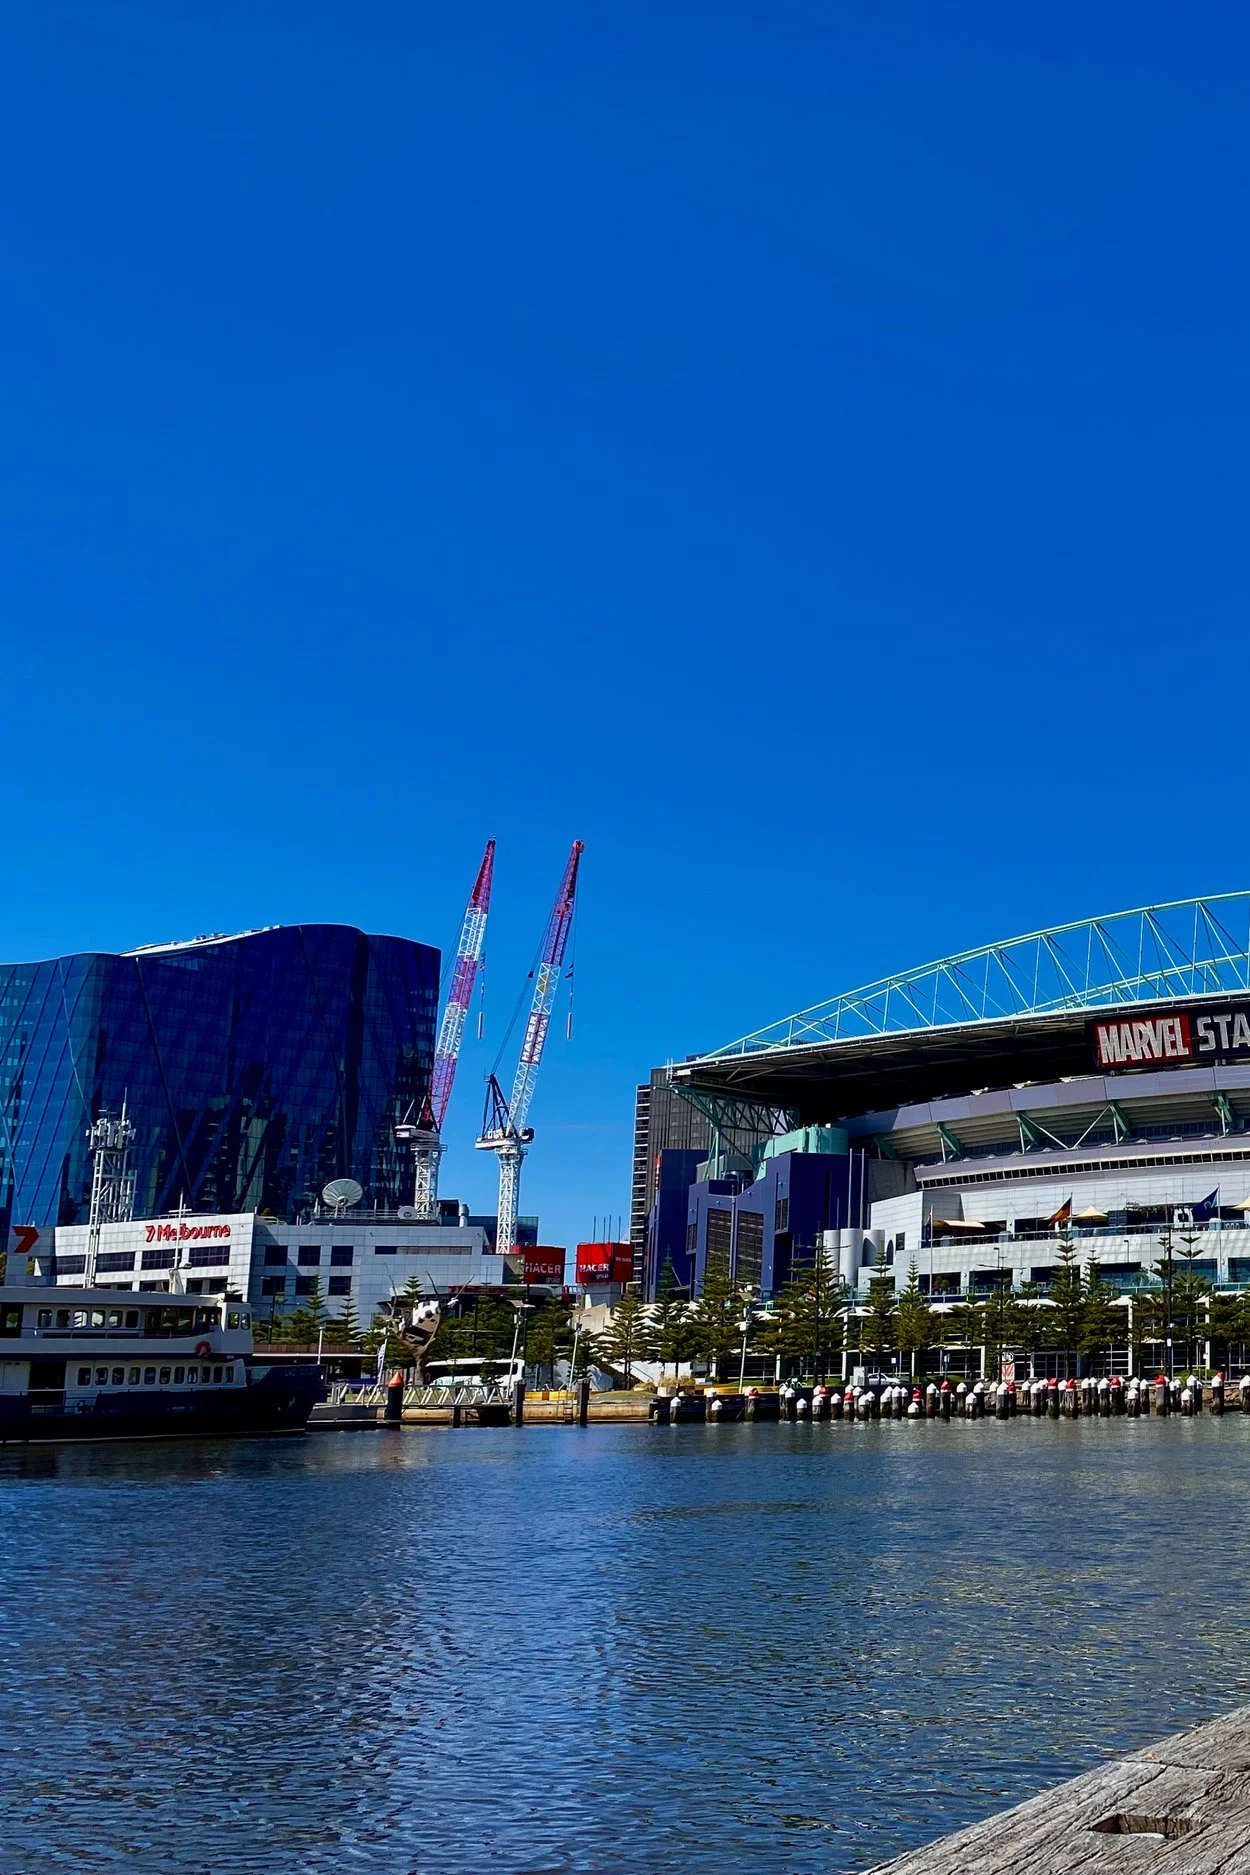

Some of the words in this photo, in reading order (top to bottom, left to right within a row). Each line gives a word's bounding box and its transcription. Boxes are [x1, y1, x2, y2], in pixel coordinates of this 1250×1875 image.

[521, 1015, 538, 1061] HACER
[1097, 1016, 1190, 1063] MARVEL
[145, 1225, 156, 1243] 7
[525, 1262, 561, 1274] HACER
[580, 1263, 609, 1273] HACER
